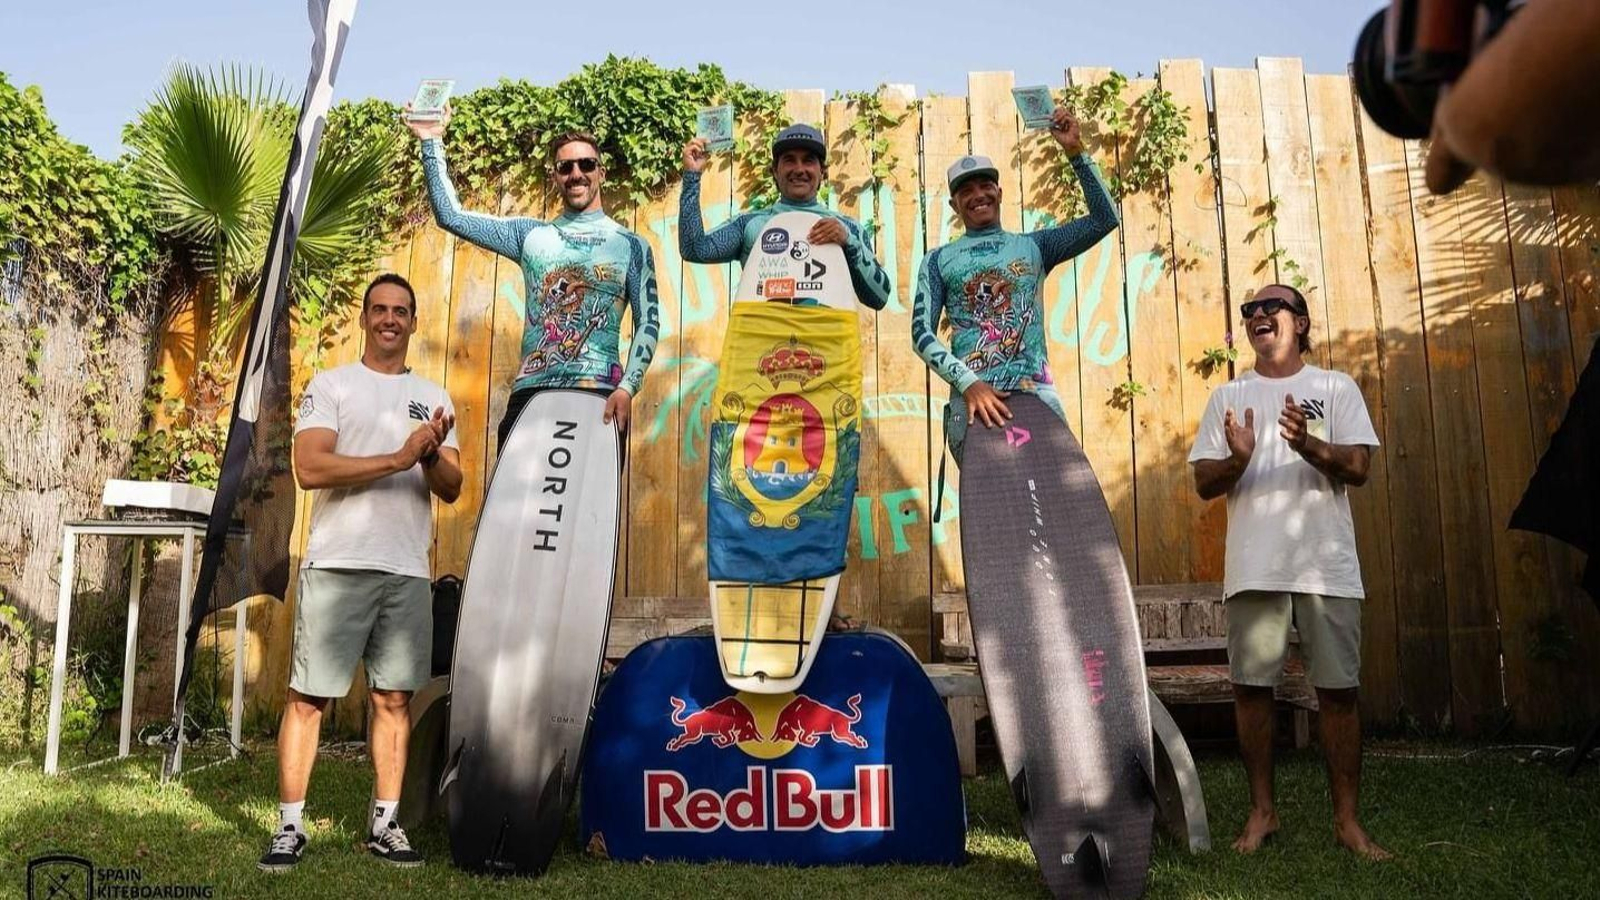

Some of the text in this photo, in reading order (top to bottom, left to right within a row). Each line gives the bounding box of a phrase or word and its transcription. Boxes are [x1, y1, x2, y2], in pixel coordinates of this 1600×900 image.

[533, 421, 578, 552] NORTH
[644, 764, 894, 832] Red Bull
